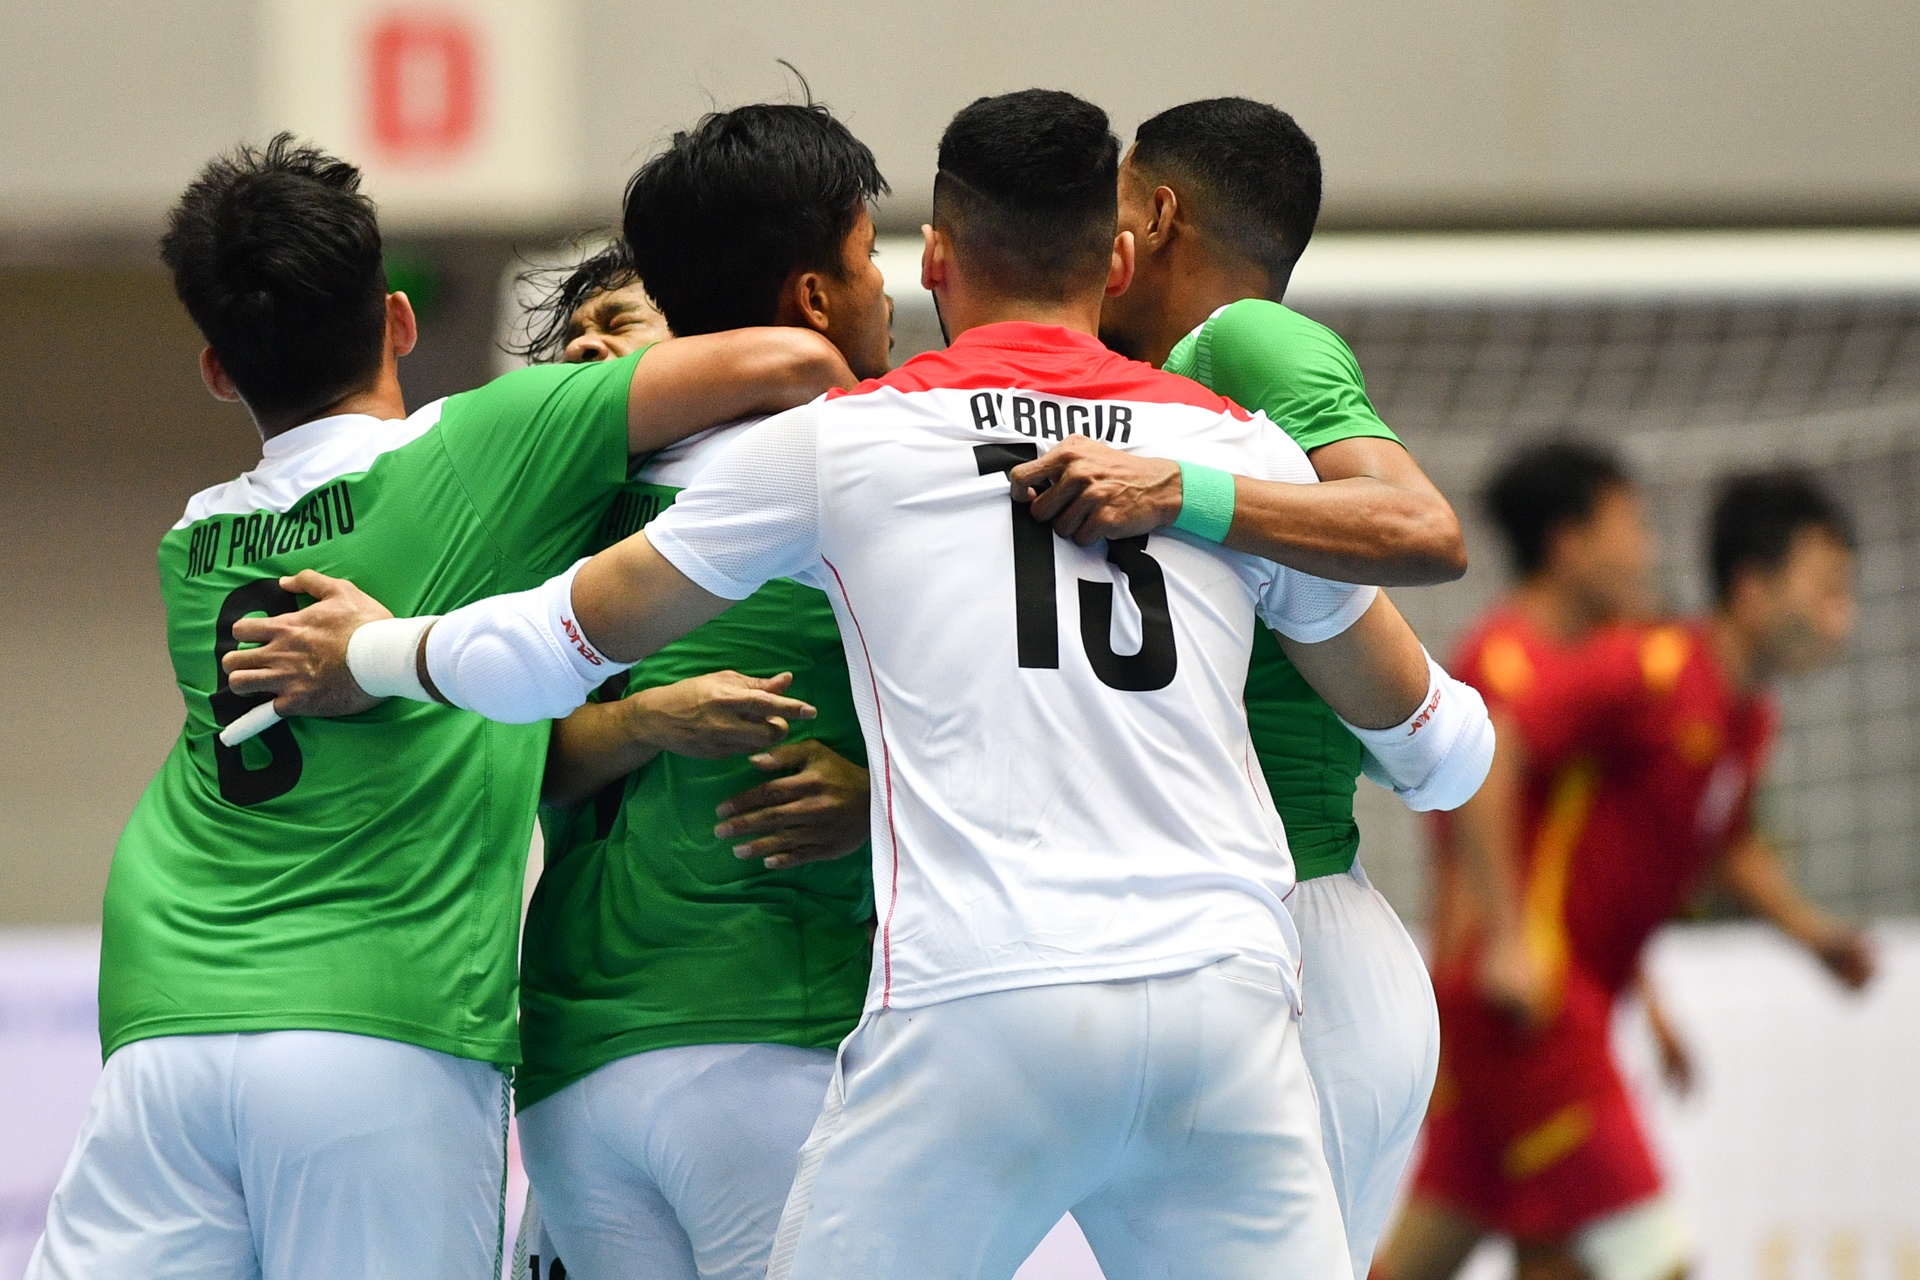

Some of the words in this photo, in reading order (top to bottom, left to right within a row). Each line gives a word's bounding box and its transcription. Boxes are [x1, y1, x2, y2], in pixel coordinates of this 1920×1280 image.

[184, 521, 222, 579] RIO
[226, 480, 355, 568] PANGESTU
[972, 442, 1178, 692] 13
